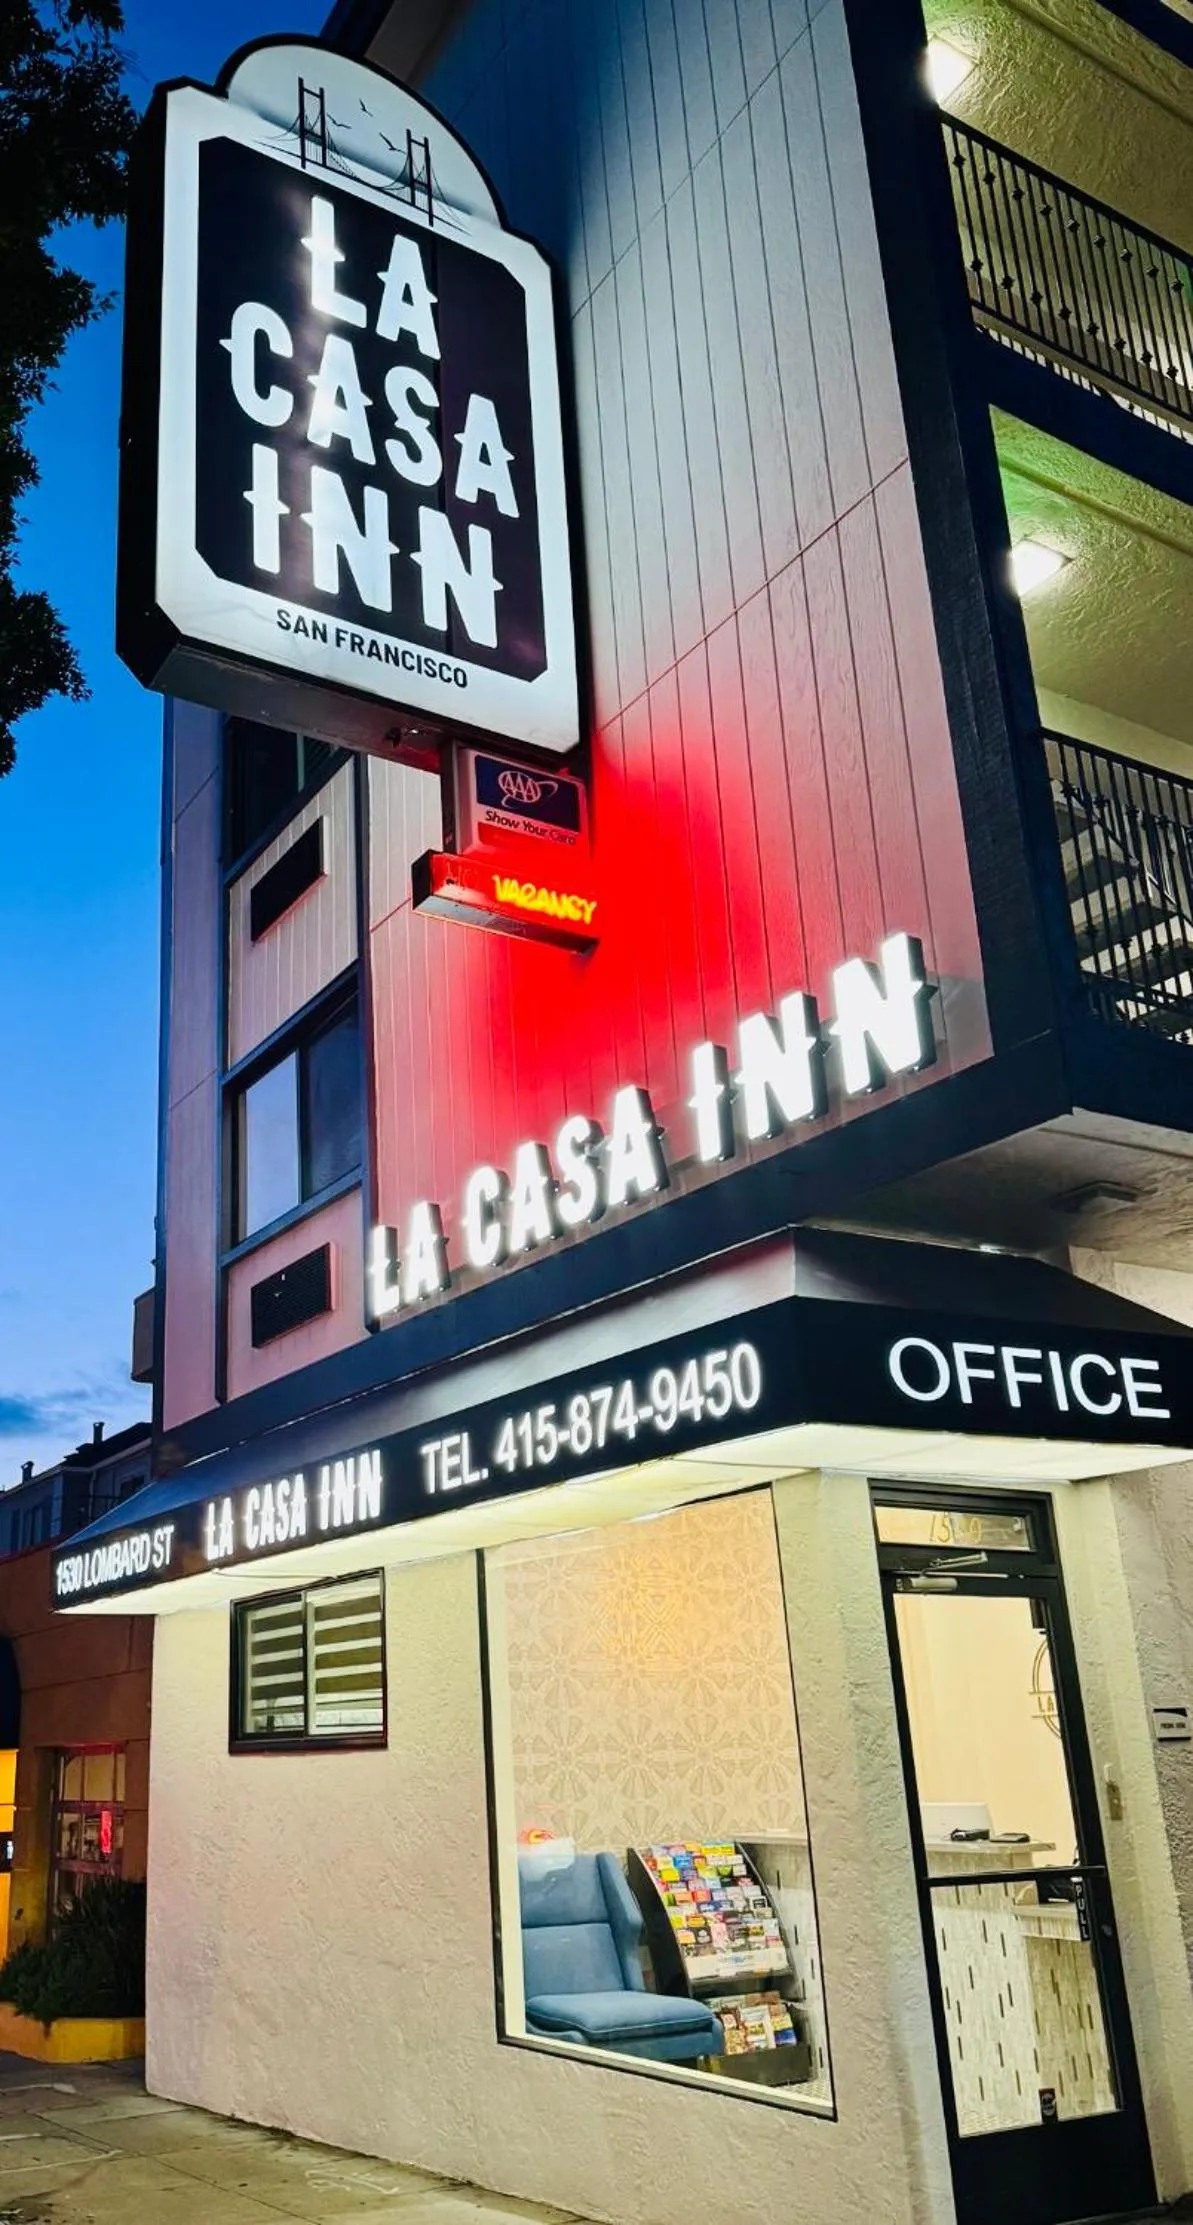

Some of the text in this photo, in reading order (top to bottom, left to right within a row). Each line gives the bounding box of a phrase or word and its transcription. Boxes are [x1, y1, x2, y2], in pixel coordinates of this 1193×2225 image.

[302, 196, 440, 360] LA
[219, 302, 519, 518] CASA
[243, 443, 503, 648] INN
[276, 608, 468, 689] SAN FRANCISCO
[485, 810, 520, 829] Show
[523, 820, 548, 837] Your
[502, 772, 541, 802] AAA
[492, 875, 598, 925] VACANCY
[368, 931, 935, 1317] LA CASA INN
[419, 1342, 762, 1495] TEL. 415-874-9450
[888, 1337, 1171, 1420] OFFICE
[204, 1449, 383, 1562] LA CASA INN
[56, 1525, 175, 1595] 1530 LOMBARD ST
[1075, 1884, 1090, 1939] PULL
